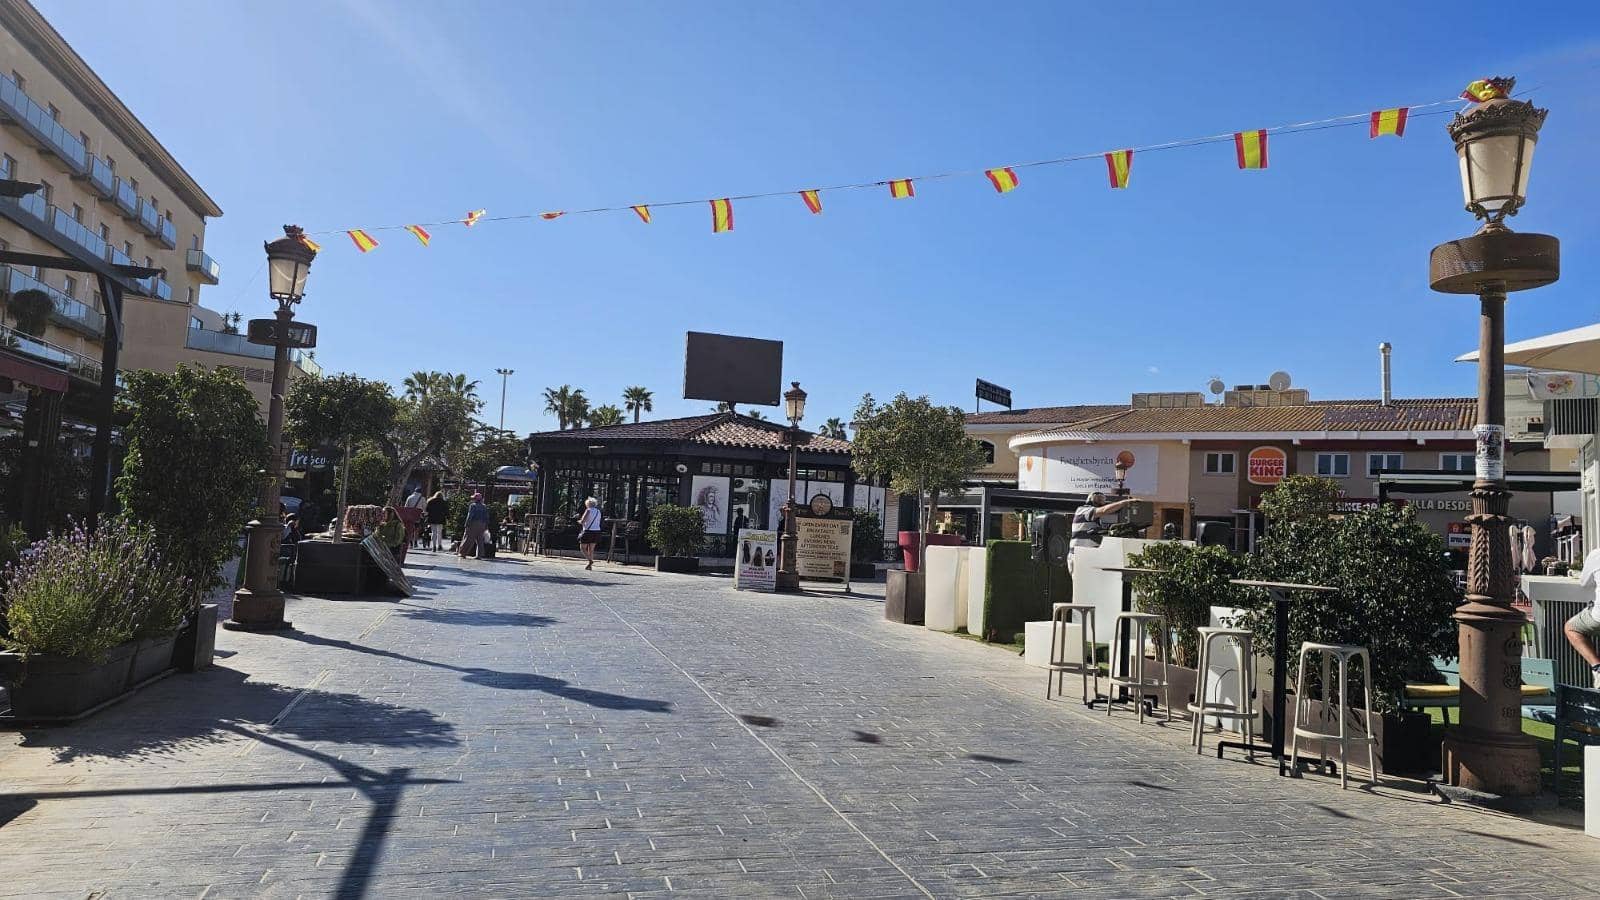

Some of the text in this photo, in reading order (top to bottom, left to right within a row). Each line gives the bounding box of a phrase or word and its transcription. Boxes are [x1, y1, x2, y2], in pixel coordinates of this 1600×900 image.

[1250, 459, 1284, 467] BURGER
[1250, 467, 1284, 476] KING
[1336, 502, 1361, 511] SINCE
[1437, 501, 1472, 510] DESDE
